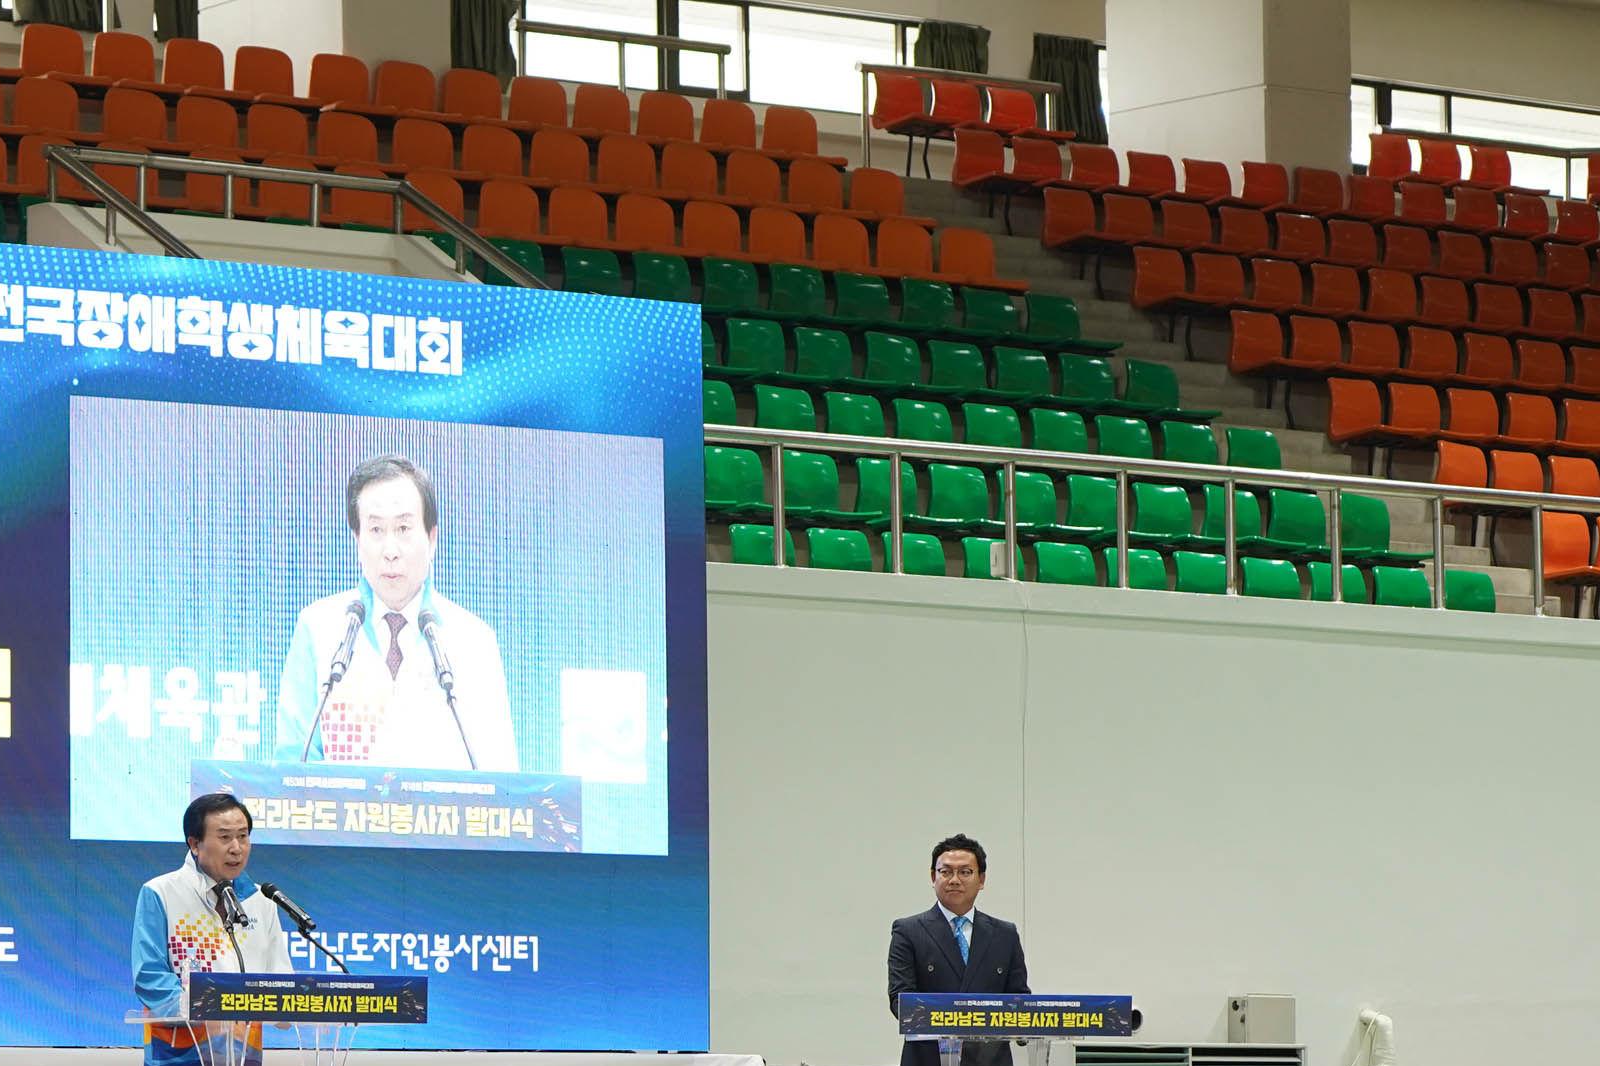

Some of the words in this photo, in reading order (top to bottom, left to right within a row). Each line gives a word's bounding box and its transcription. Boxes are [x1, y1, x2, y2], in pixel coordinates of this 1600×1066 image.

[244, 797, 338, 831] 전라남도
[344, 801, 460, 836] 자원봉사자
[466, 806, 534, 839] 발대식
[221, 993, 277, 1011] 전라남도
[282, 994, 352, 1013] 자원봉사자
[356, 996, 398, 1014] 발대식
[930, 1011, 986, 1027] 전라남도
[990, 1011, 1060, 1028] 자원봉사자
[1063, 1012, 1103, 1028] 발대식
